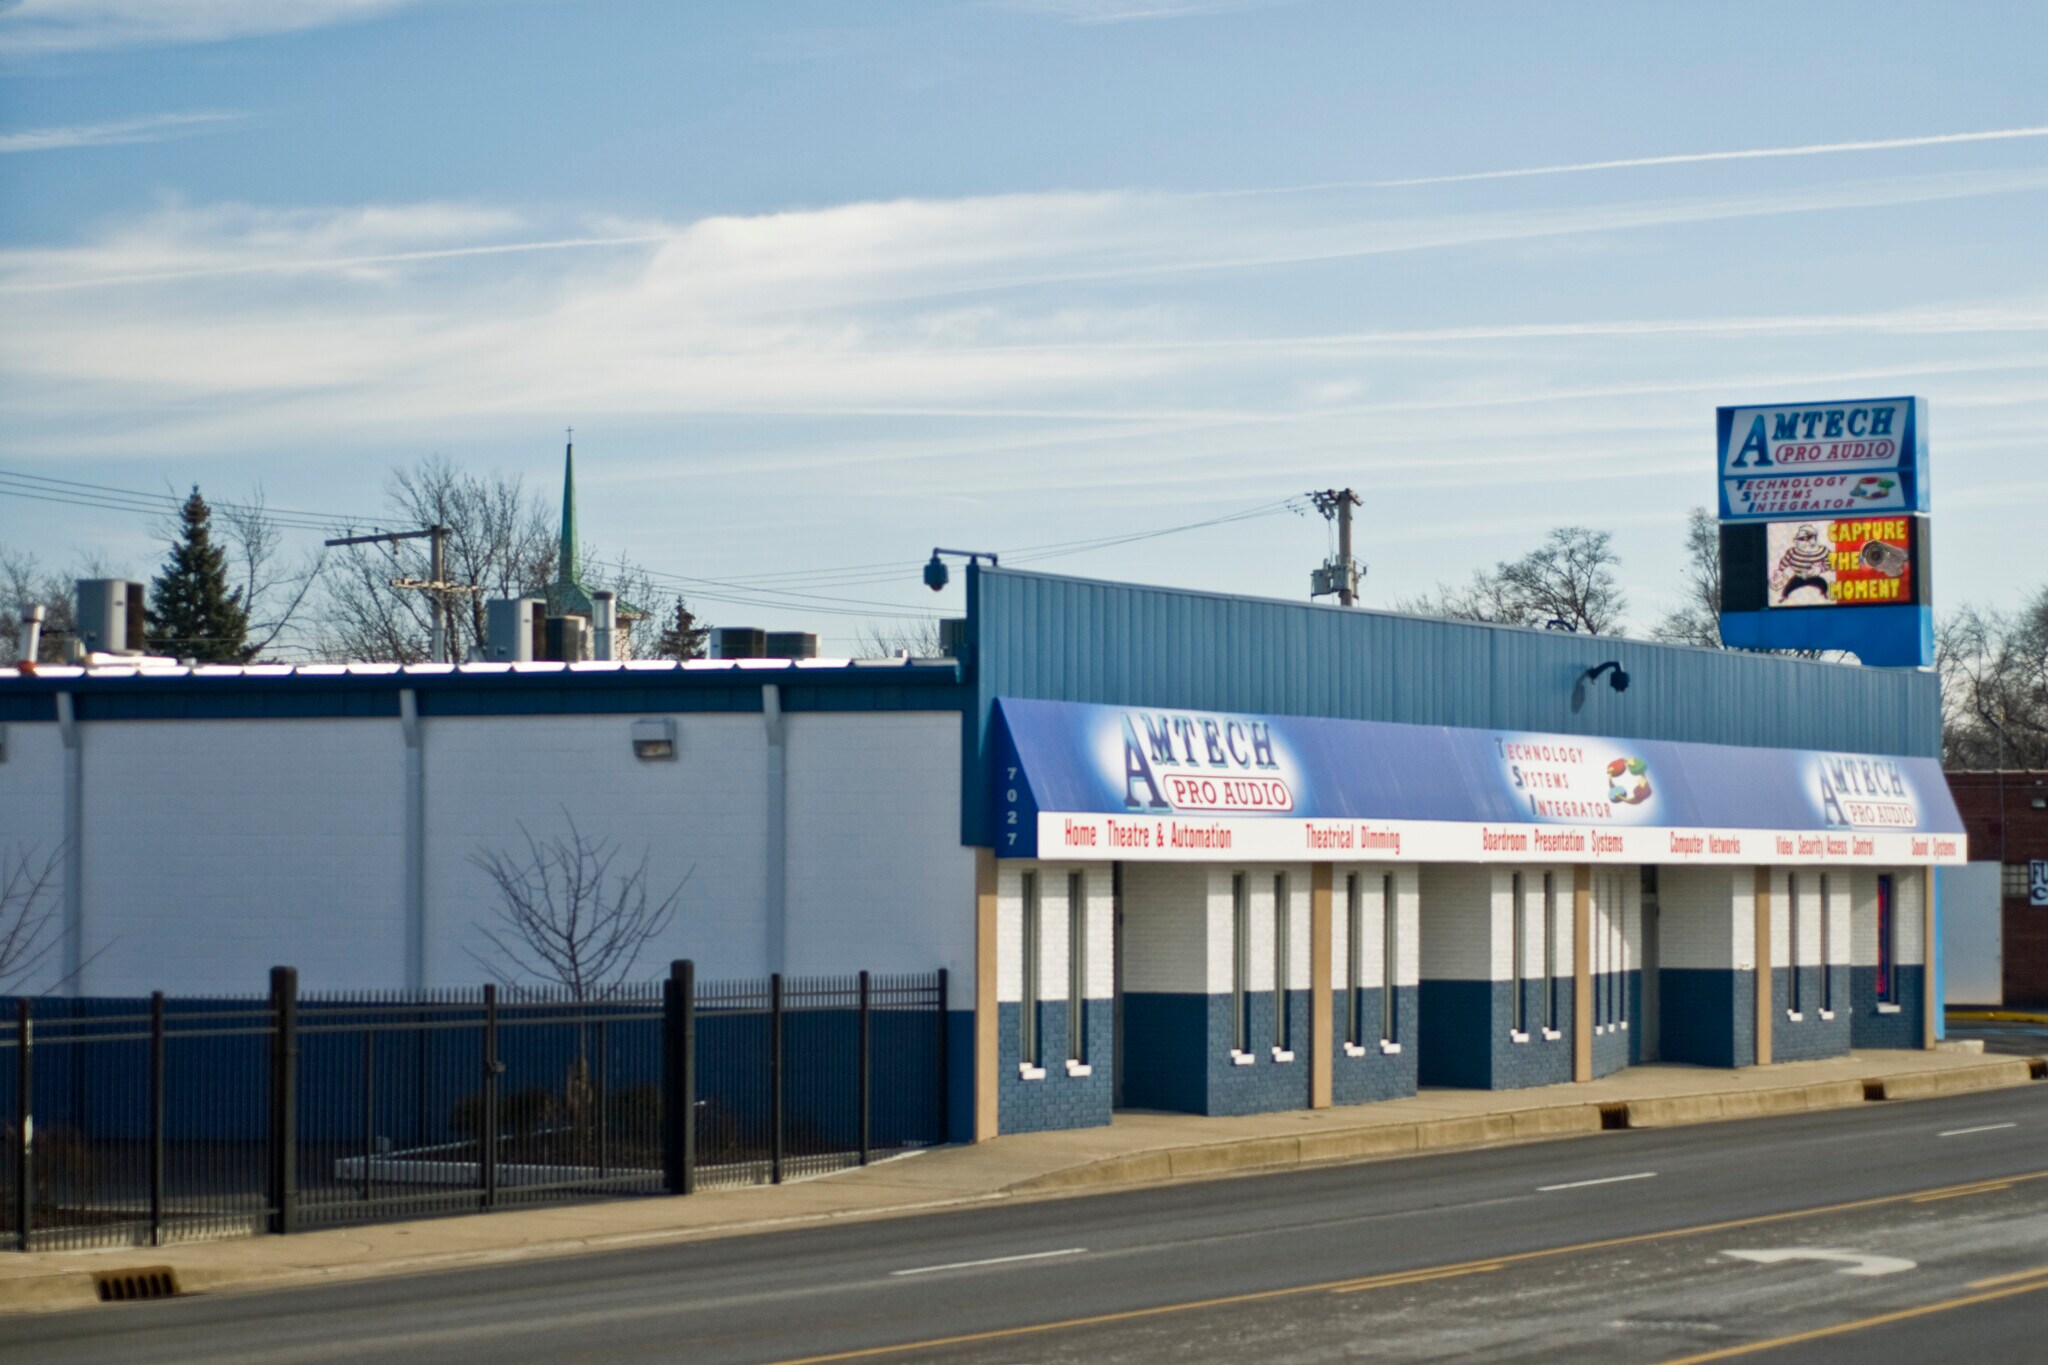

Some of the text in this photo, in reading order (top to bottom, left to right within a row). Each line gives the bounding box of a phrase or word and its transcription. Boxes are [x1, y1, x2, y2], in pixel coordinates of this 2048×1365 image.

[1731, 406, 1895, 468] AMTECH
[1783, 441, 1889, 462] PRO AUDIO
[1736, 476, 1848, 491] TECHNOLOGY
[1740, 489, 1812, 502] SYSTEMS
[1747, 498, 1855, 513] INTEGRATOR
[1827, 520, 1905, 543] CAPTURE
[1829, 552, 1860, 571] THE
[1829, 578, 1900, 600] MOMENT
[1120, 711, 1280, 813] AMTECH
[1494, 737, 1584, 764] TECHNOLOGY
[1511, 765, 1570, 790] SYSTEMS
[1173, 779, 1288, 807] PRO AUDIO
[1819, 755, 1907, 829] AMTECH
[1529, 794, 1612, 819] INTEGRATOR
[1849, 804, 1914, 825] PRO AUDIO
[1065, 818, 1232, 849] Home Theatre & Automation
[1305, 823, 1401, 855] Theatrical Dimming
[1482, 827, 1623, 858] Boardroom Presentation Systems
[1670, 831, 1741, 858] Computer Networks
[1776, 835, 1874, 859] Video Security Access Control
[1911, 838, 1956, 858] Sound Systems
